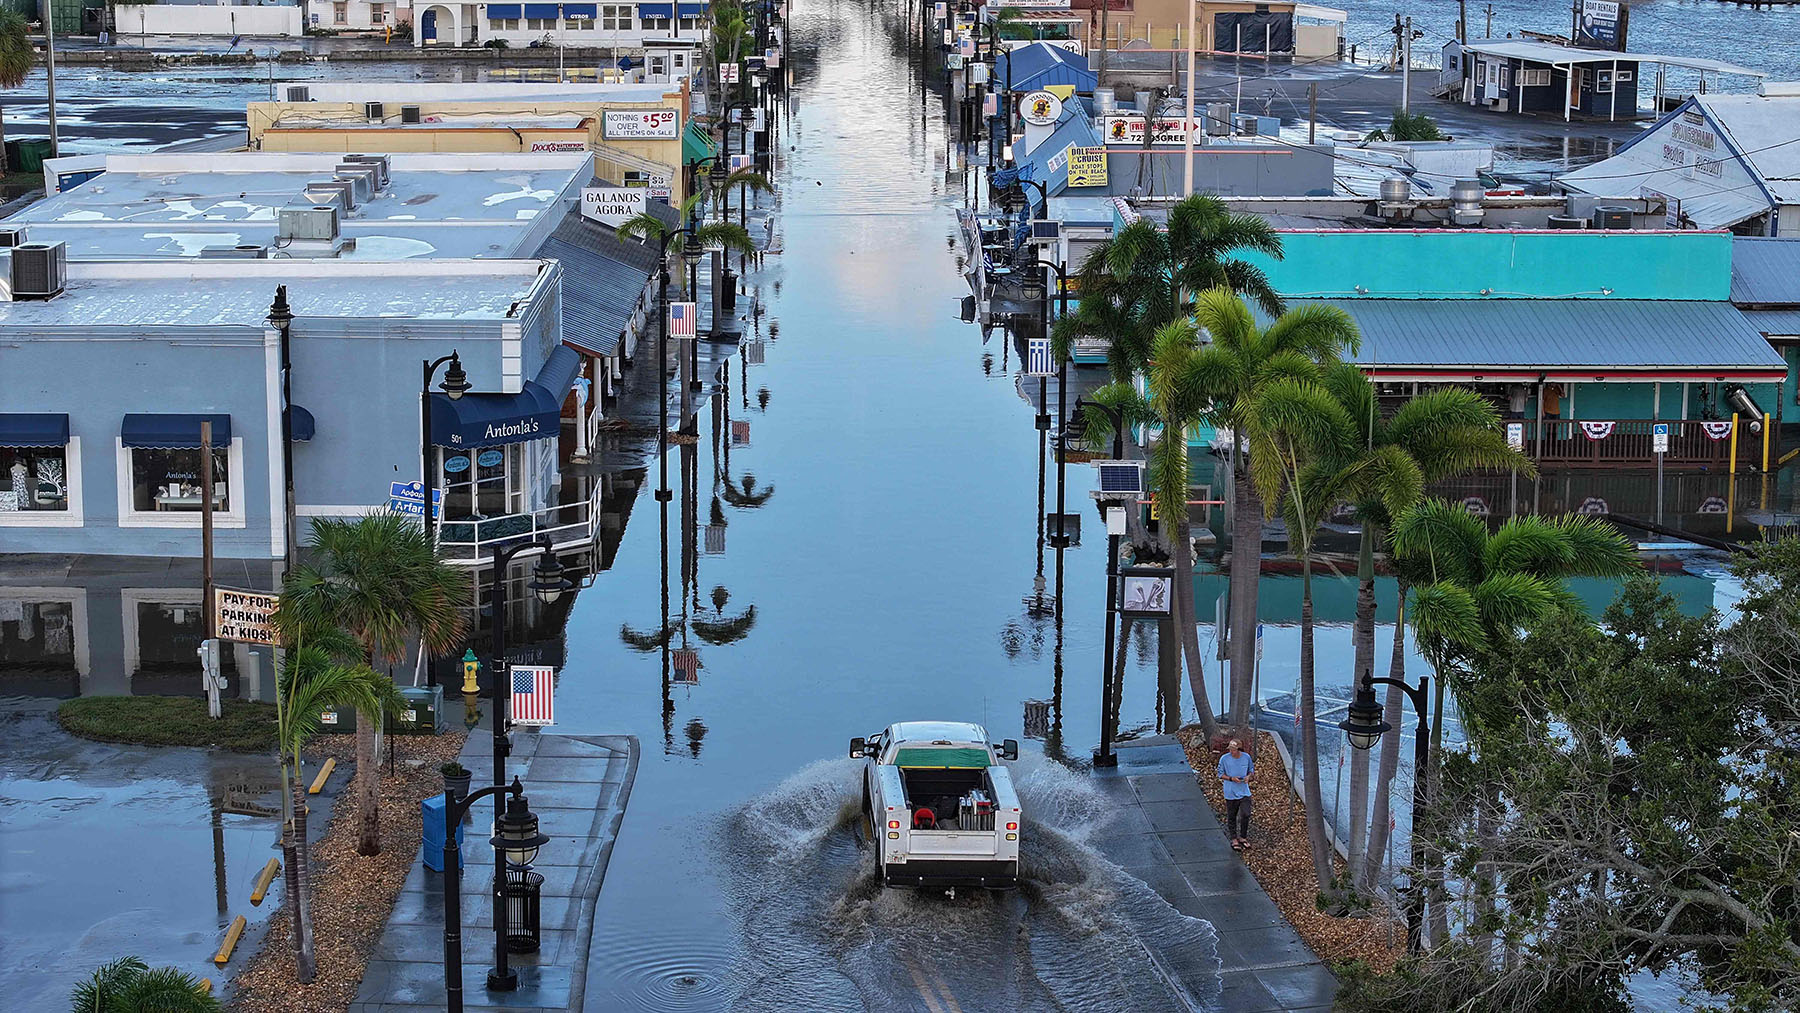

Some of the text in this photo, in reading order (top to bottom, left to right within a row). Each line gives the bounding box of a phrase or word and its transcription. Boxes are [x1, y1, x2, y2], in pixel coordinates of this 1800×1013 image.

[607, 114, 639, 122] NOTHING
[616, 122, 639, 130] OVER
[1077, 155, 1103, 163] CRUISE
[586, 193, 641, 203] GALANOS
[594, 204, 633, 215] AGORA
[485, 417, 539, 439] Antonia's
[451, 434, 462, 444] 501
[224, 593, 272, 609] PAY FOR
[222, 625, 235, 636] AT
